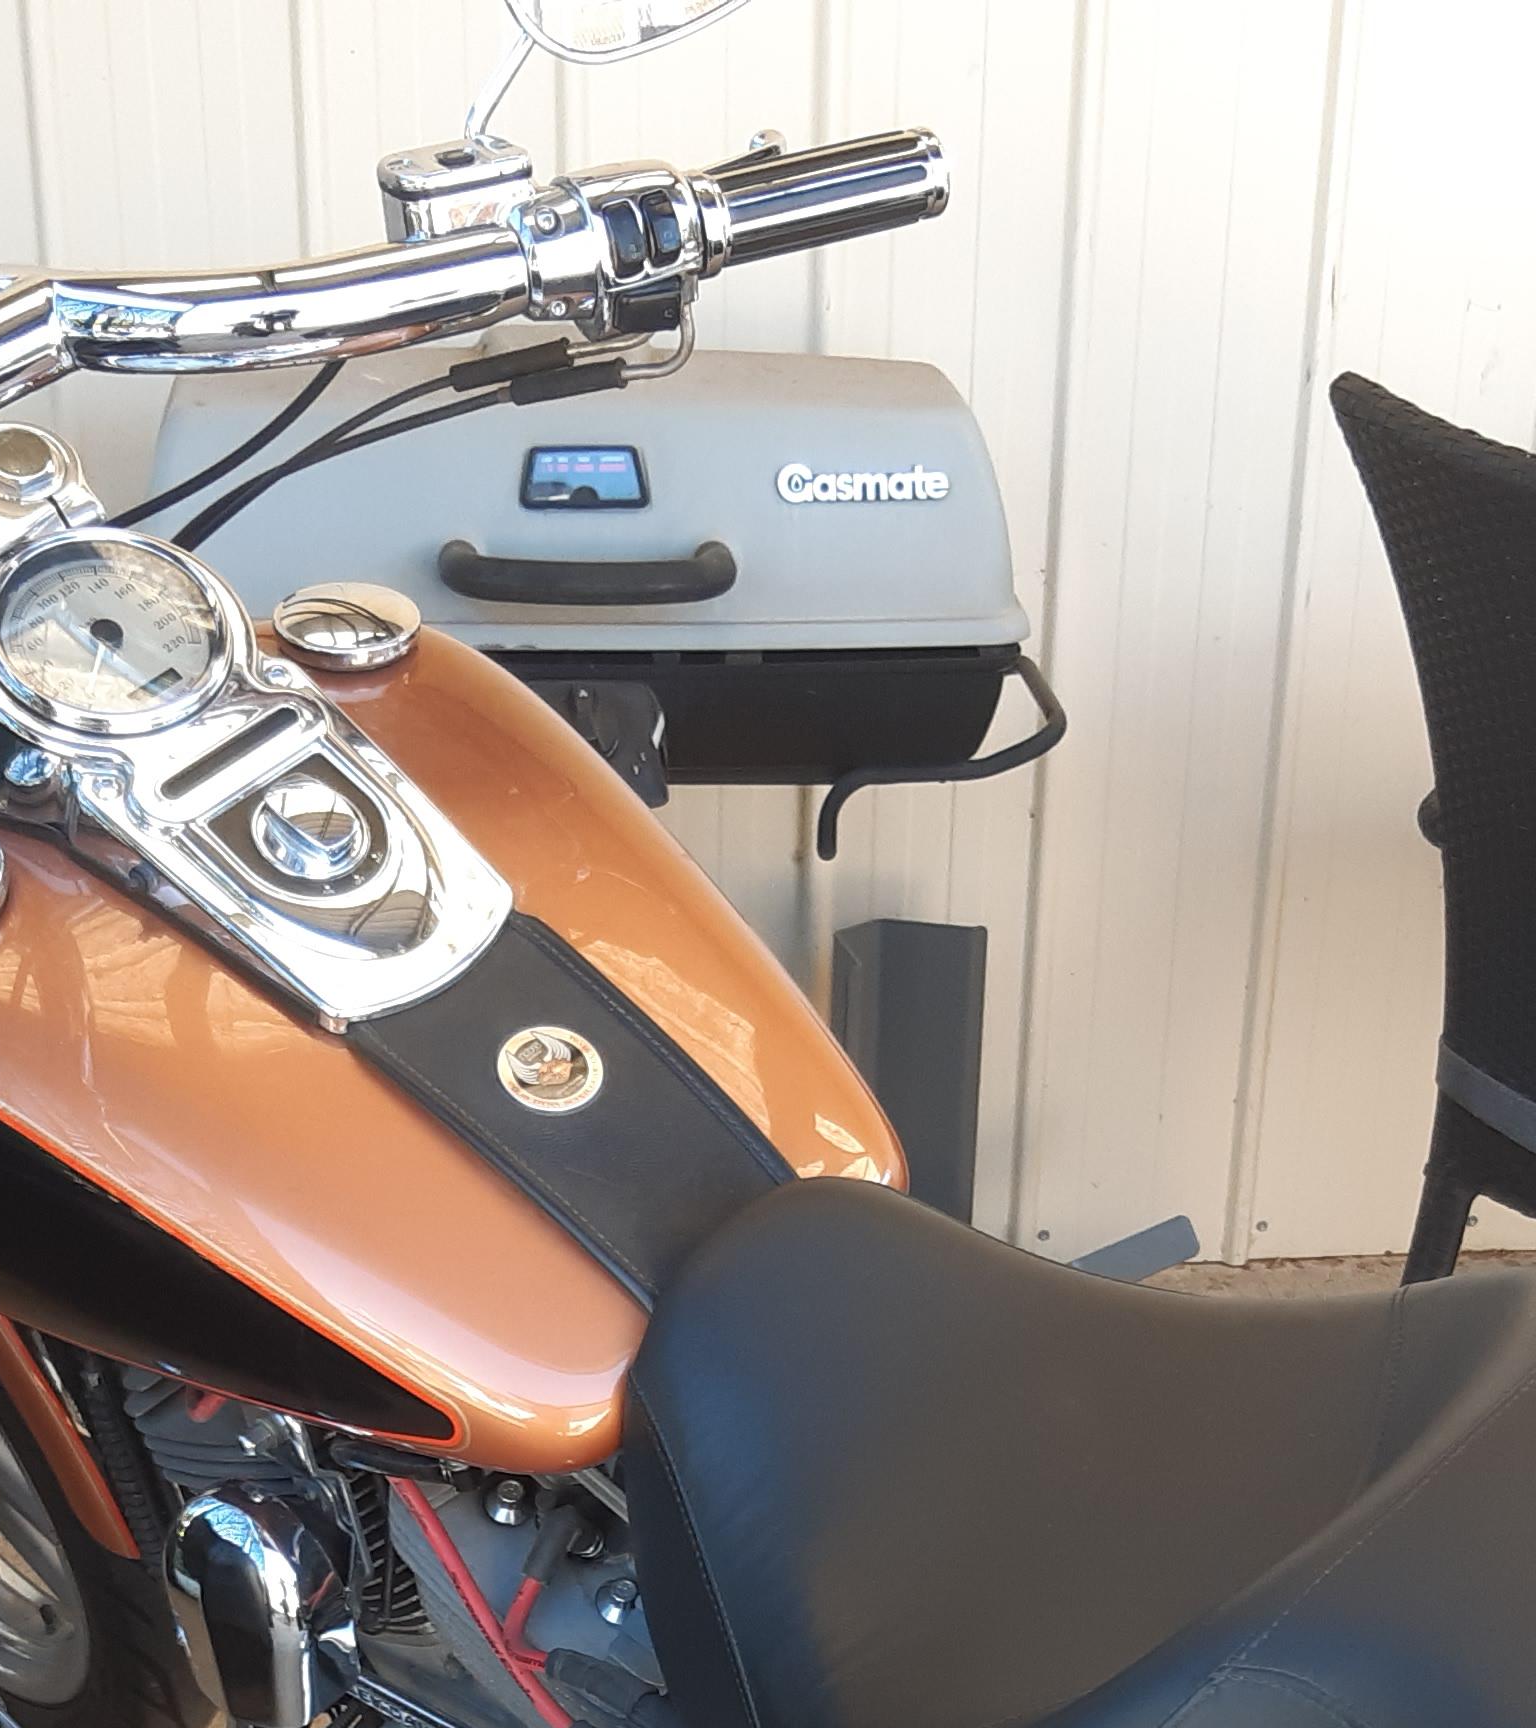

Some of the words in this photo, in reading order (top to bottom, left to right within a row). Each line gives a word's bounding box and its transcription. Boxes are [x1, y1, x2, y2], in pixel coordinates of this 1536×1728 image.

[777, 463, 950, 503] Gasmate
[58, 581, 81, 599] 120
[87, 578, 110, 595] 140
[113, 583, 137, 600] 160
[35, 594, 59, 611] 100
[153, 612, 177, 631] 200
[162, 635, 187, 654] 220
